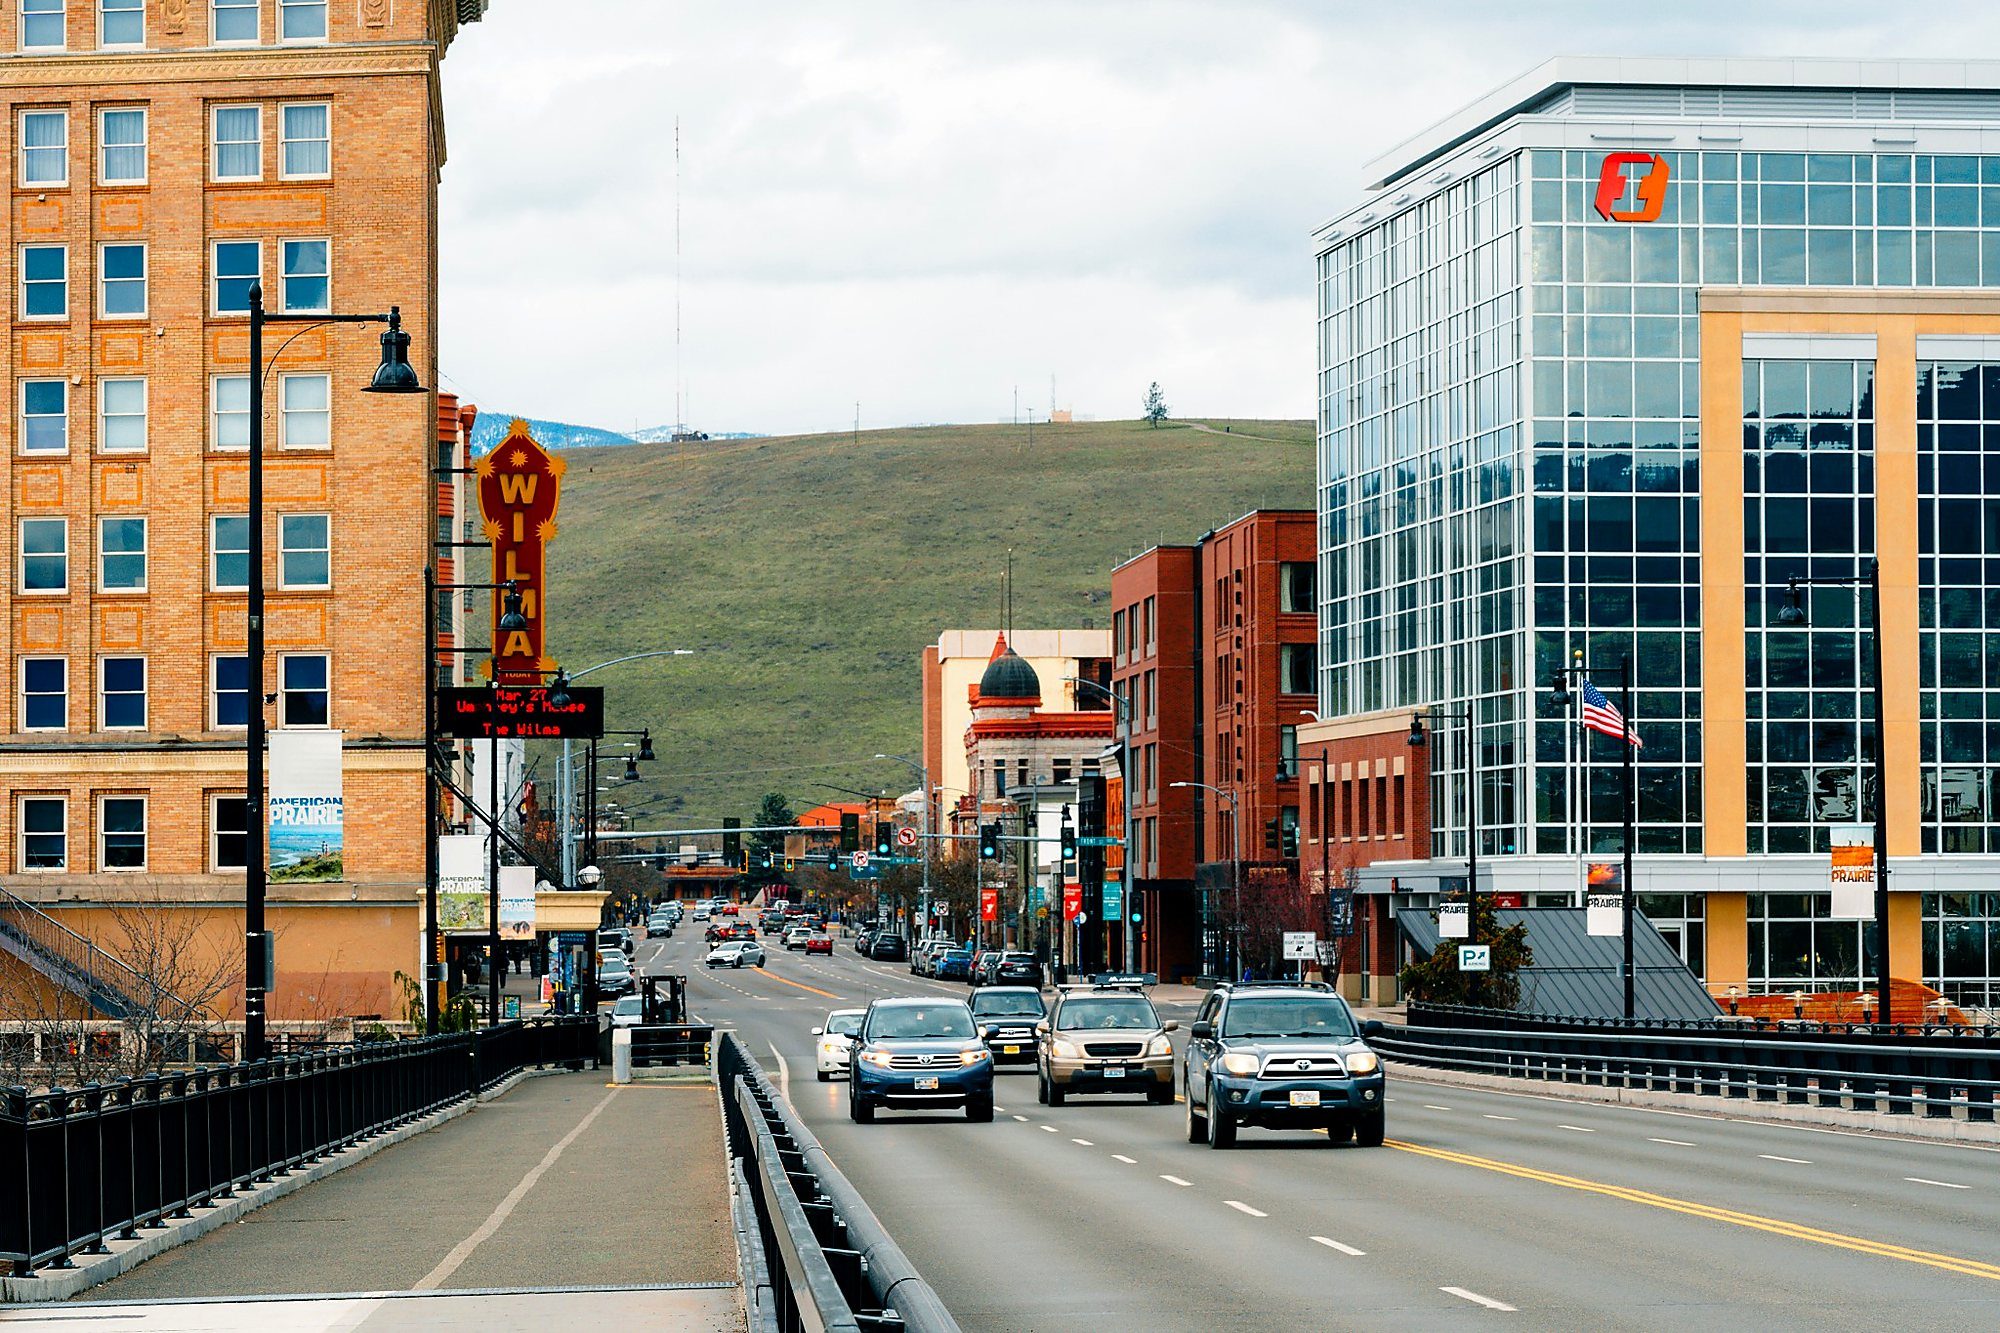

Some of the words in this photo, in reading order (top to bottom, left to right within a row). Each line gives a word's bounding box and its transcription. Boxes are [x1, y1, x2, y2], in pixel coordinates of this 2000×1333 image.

[500, 473, 539, 657] WILMA
[496, 689, 522, 701] Mar
[530, 689, 547, 701] 27
[516, 723, 561, 736] Wilma
[269, 797, 343, 806] AMERICAN
[269, 805, 343, 825] PRAIRIE
[1831, 869, 1875, 882] PRAIRIE
[440, 881, 485, 893] PRAIRIE
[1588, 898, 1623, 908] PRAIRIE
[1440, 906, 1468, 914] PRAIRIE
